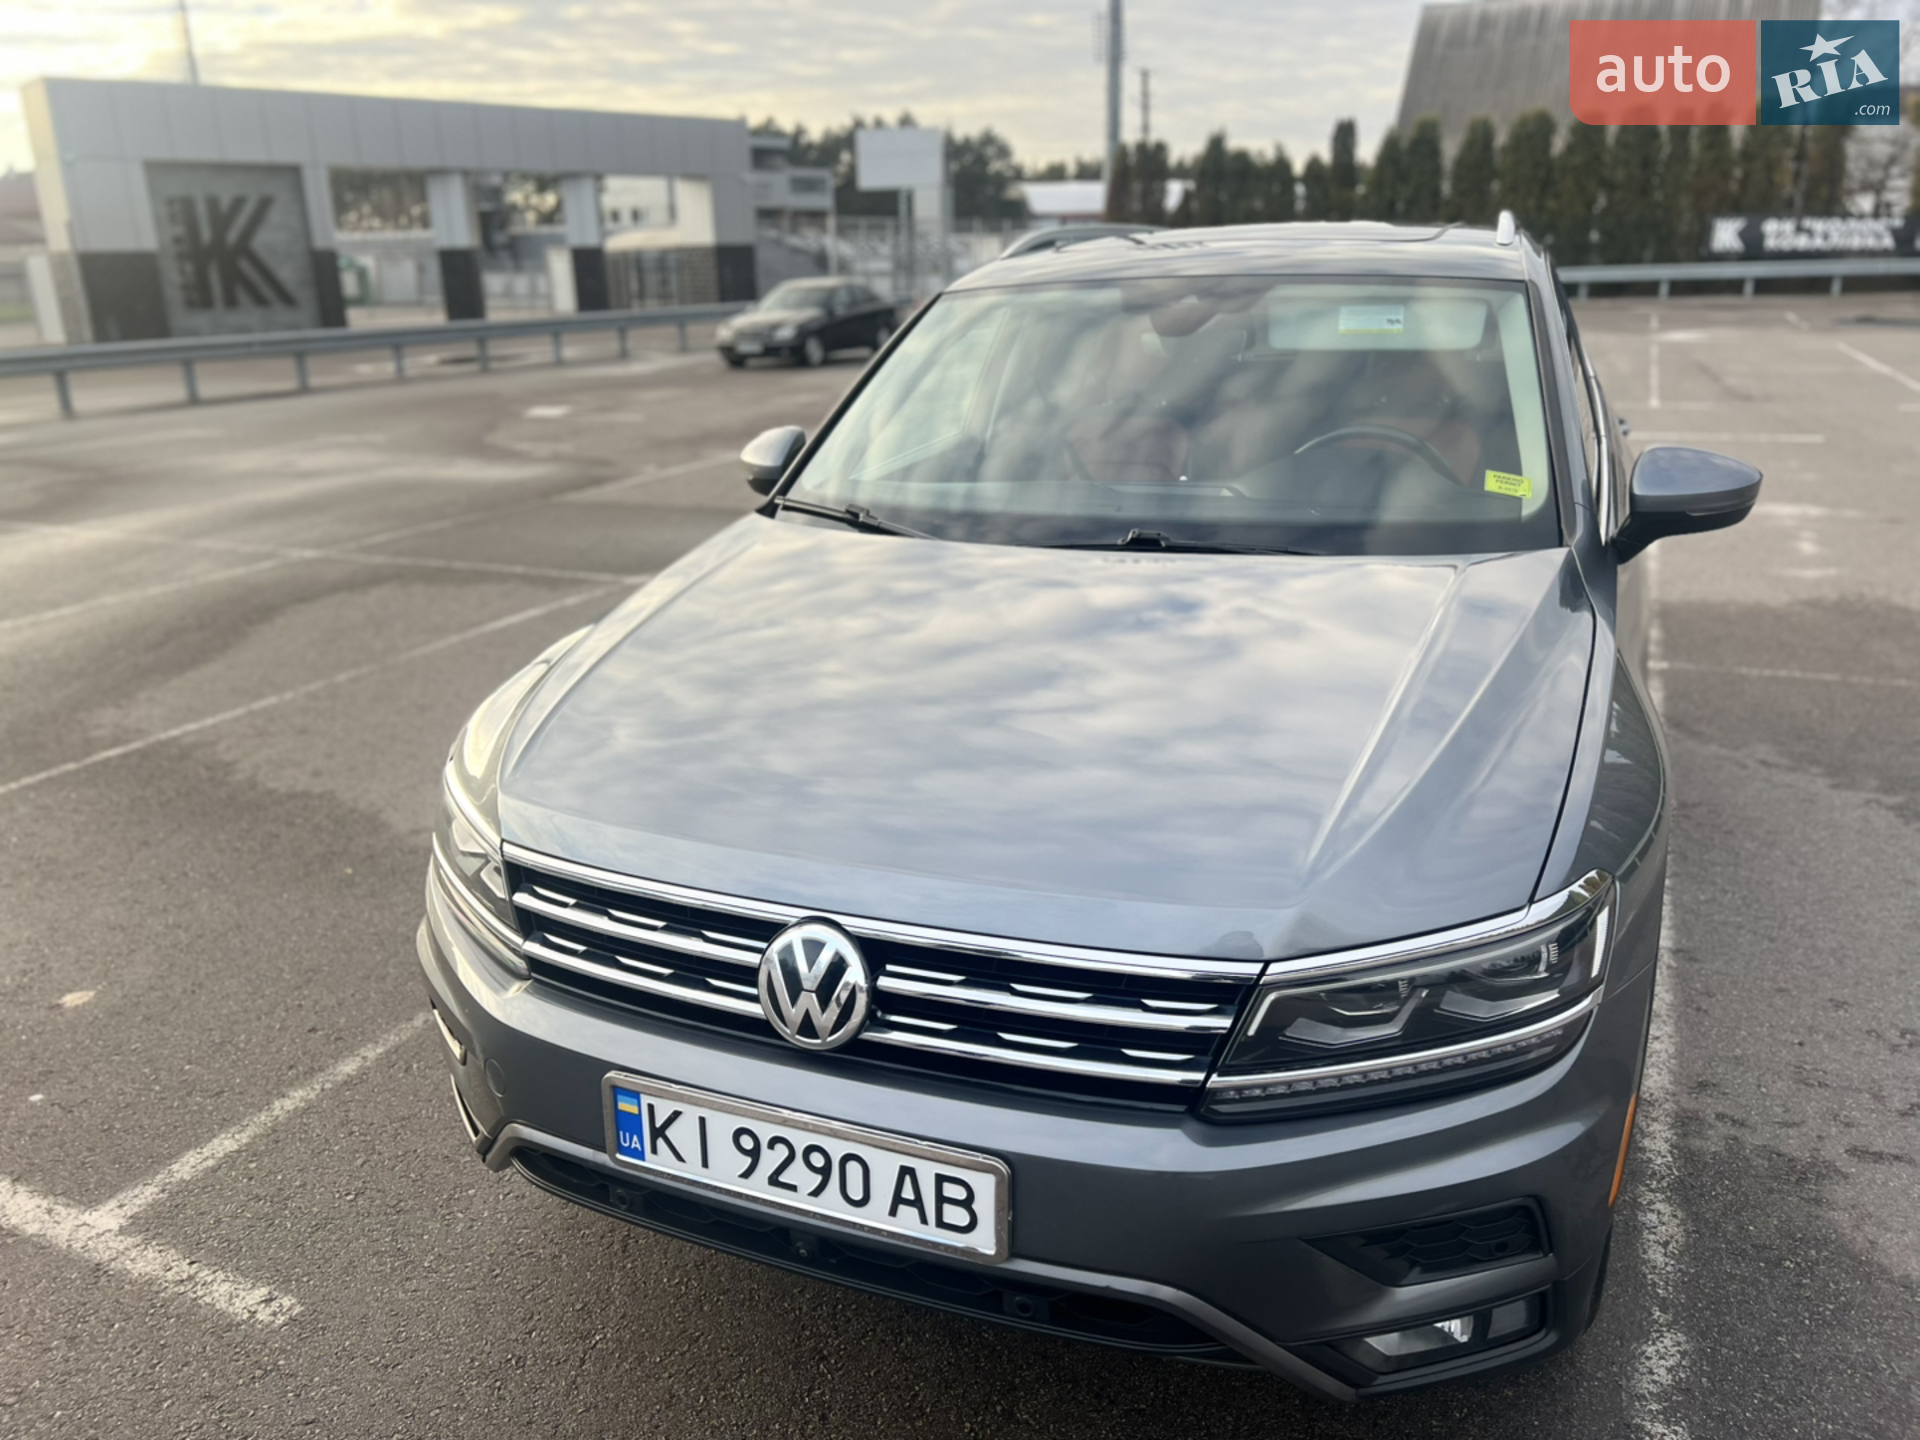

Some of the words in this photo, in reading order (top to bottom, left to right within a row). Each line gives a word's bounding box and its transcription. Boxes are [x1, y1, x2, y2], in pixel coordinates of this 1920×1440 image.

[1493, 474, 1524, 484] PARKING
[1495, 479, 1521, 488] PERMIT
[619, 1130, 642, 1151] UA
[647, 1103, 709, 1169] KI
[731, 1126, 870, 1208] 9290
[888, 1164, 978, 1234] AB
